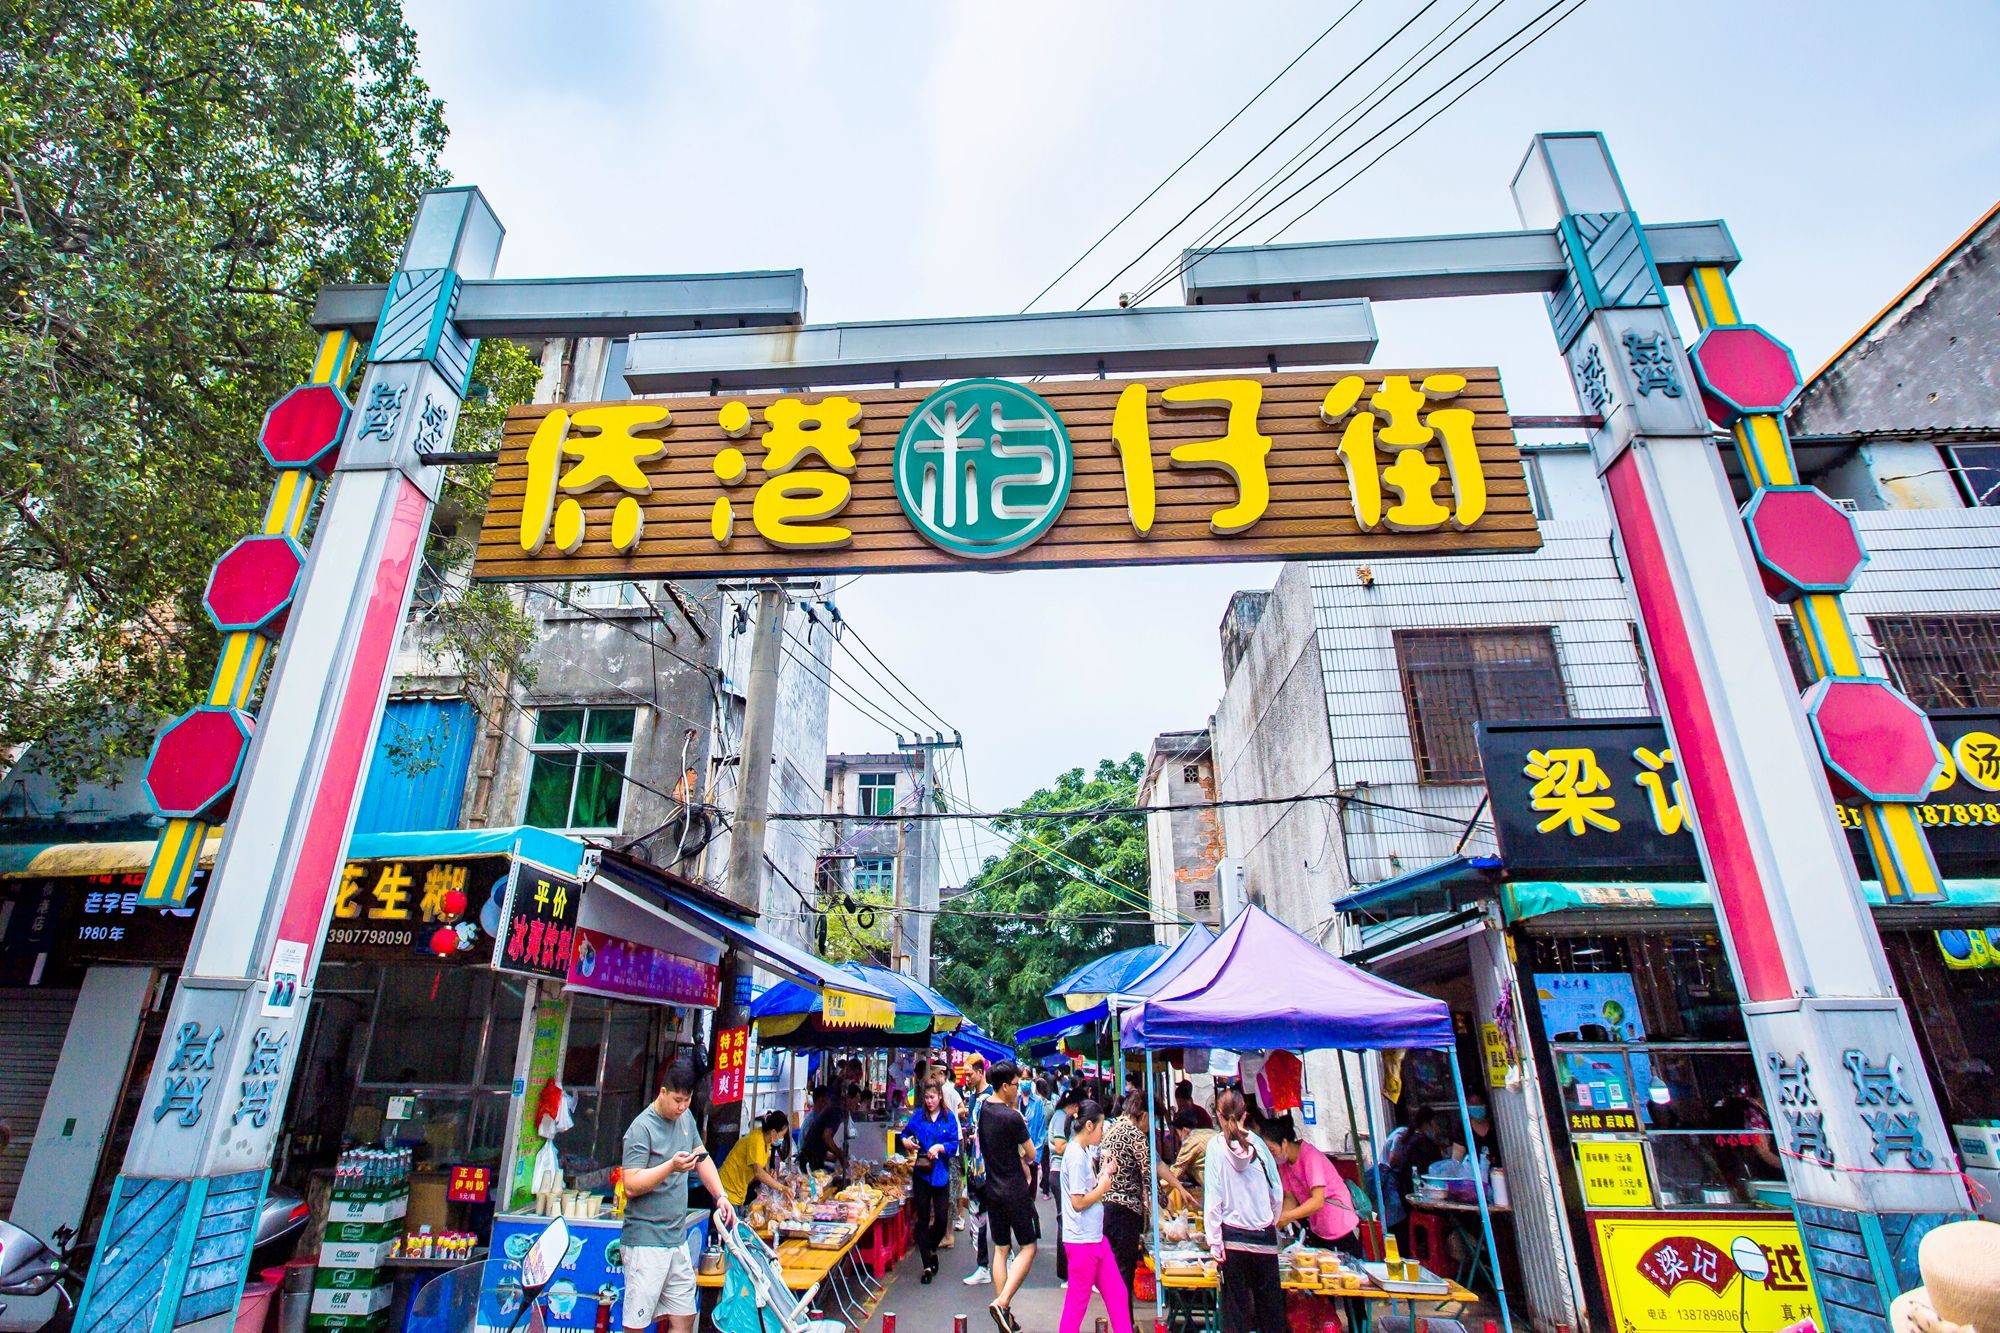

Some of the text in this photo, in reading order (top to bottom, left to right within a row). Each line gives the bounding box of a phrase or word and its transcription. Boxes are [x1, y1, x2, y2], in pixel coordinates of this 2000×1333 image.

[84, 892, 138, 914] 老字号
[533, 879, 567, 919] 平价
[1572, 1115, 1635, 1128] 先付款 后取餐
[459, 1168, 483, 1179] 正品
[455, 1180, 484, 1191] 伊利奶
[1654, 1243, 1717, 1285] 梁记
[1780, 1303, 1813, 1321] 真材
